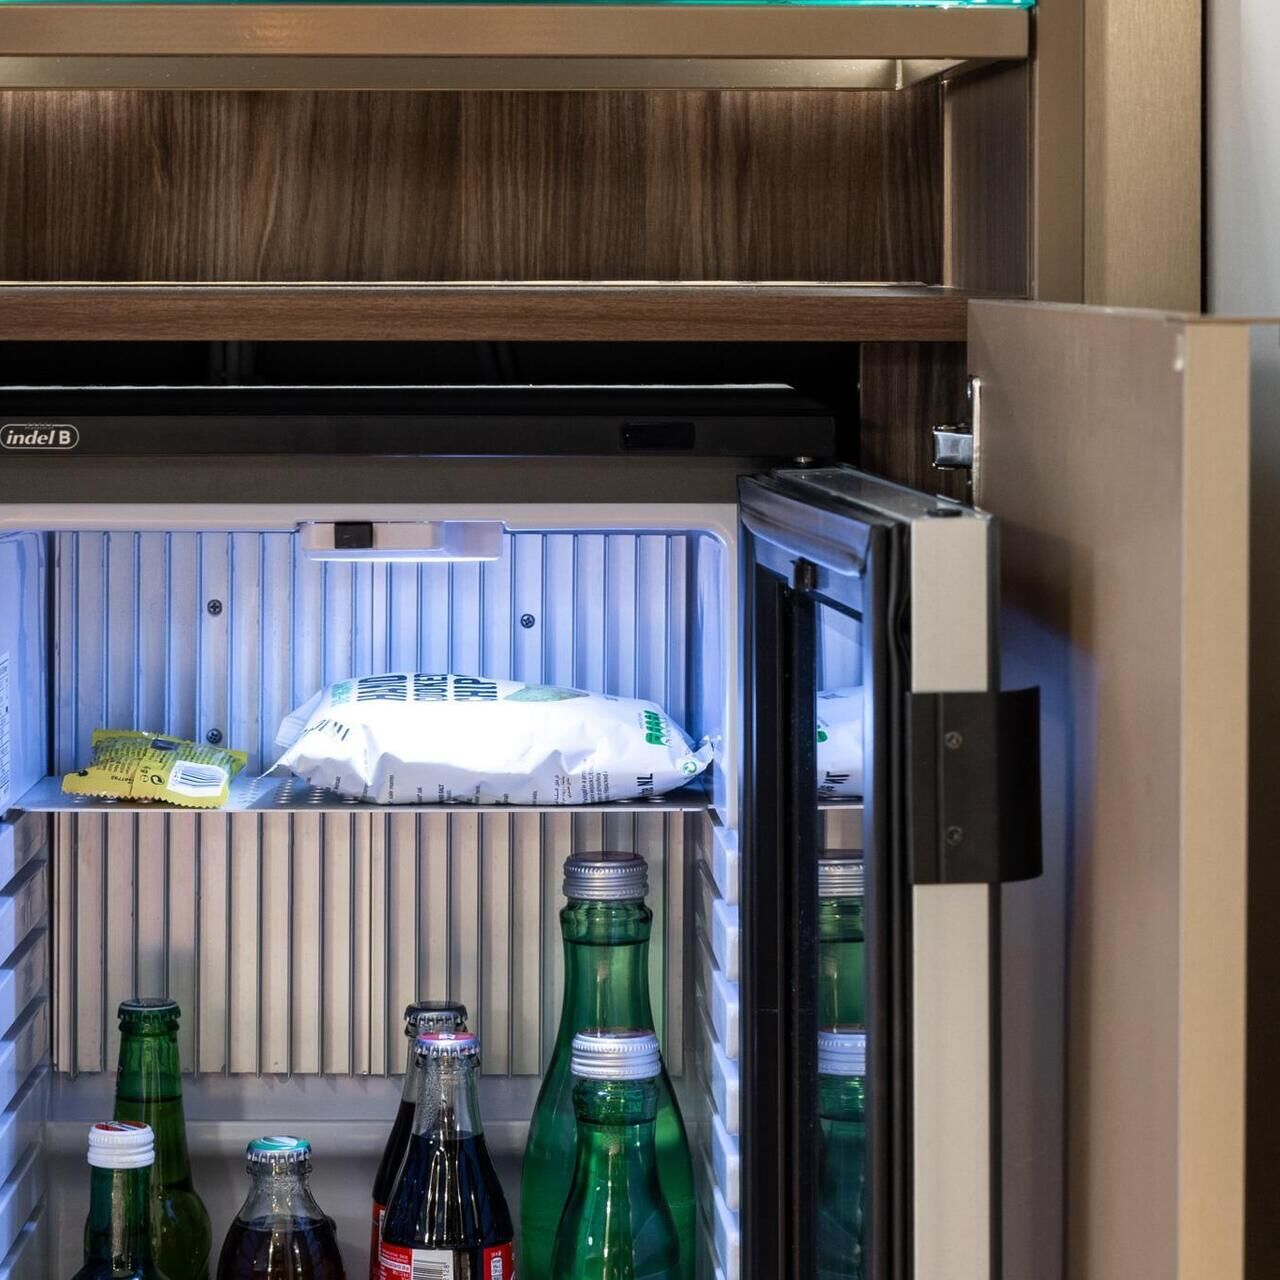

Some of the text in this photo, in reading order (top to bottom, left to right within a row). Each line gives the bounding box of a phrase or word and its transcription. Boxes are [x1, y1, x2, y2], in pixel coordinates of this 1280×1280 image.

[5, 430, 71, 445] indel B
[357, 674, 407, 702] HAND
[452, 674, 498, 702] CHIP
